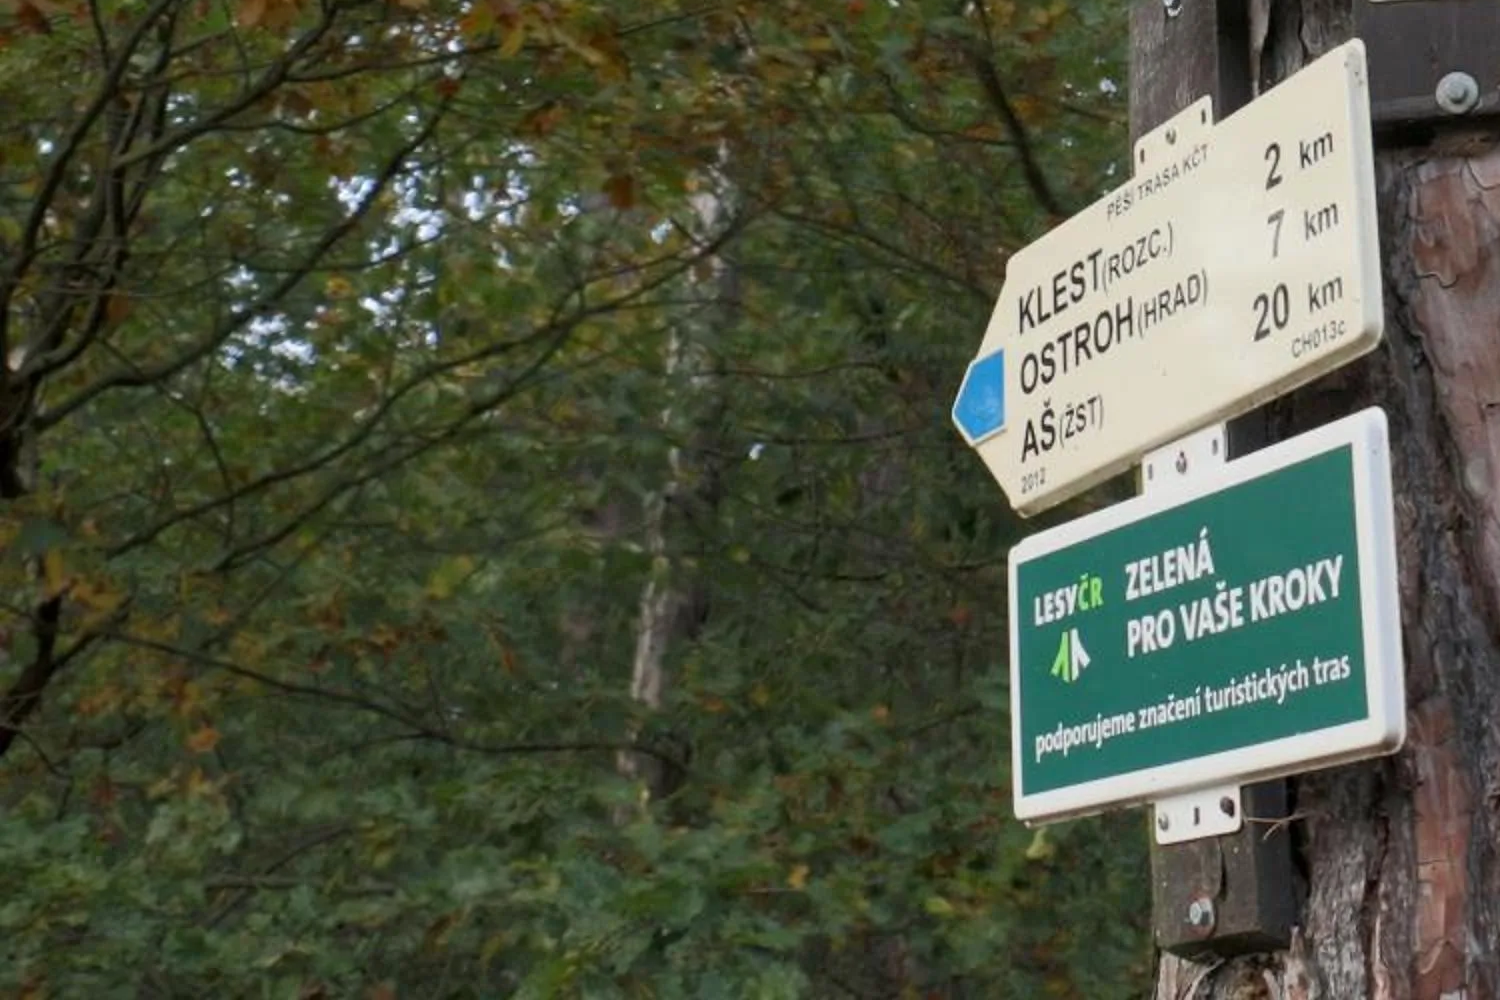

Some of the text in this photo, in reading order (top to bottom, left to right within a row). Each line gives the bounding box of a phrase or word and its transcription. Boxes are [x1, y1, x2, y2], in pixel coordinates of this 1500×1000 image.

[1018, 248, 1103, 335] KLEST
[1264, 142, 1283, 191] 2
[1299, 132, 1333, 169] km
[1137, 163, 1180, 200] TRASA
[1020, 203, 1338, 395] OSTROH (HRAD) 7 km
[1021, 397, 1056, 463] AŠ
[1253, 283, 1290, 342] 20
[1308, 277, 1343, 313] km
[1125, 526, 1215, 601] ZELENÁ
[1127, 554, 1343, 658] PRO VAŠE KROKY
[1035, 655, 1351, 763] podporujeme značení turistických tras
